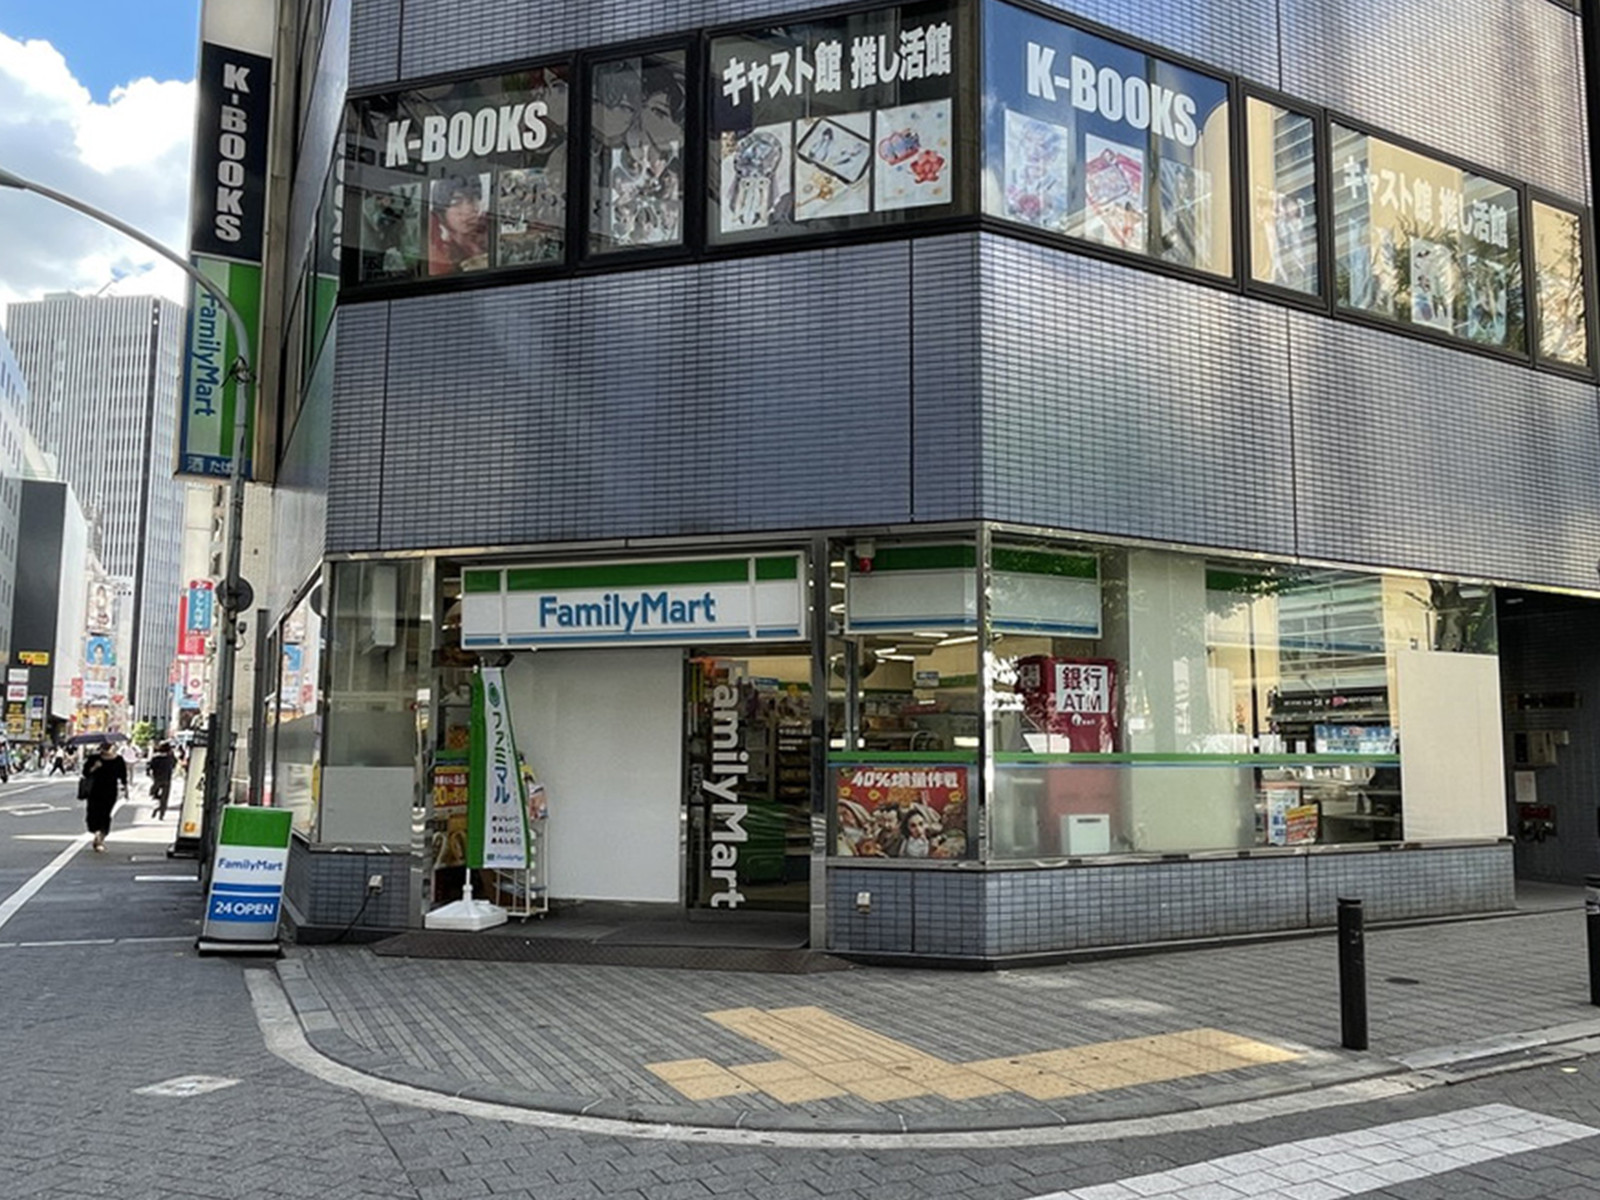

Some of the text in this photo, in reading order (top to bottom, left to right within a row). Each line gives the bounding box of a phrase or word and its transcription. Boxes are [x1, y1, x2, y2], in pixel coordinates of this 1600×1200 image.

[723, 22, 951, 107] キャスト館 推し活館
[1027, 41, 1198, 147] K-BOOKS
[215, 63, 250, 243] K-BOOKS
[385, 100, 548, 168] K-BOOKS
[1343, 155, 1433, 223] キャスト館
[539, 592, 716, 633] FamilyMart
[1062, 666, 1103, 691] 銀行
[1062, 693, 1103, 711] ATM
[492, 711, 510, 804] ファミマル
[218, 857, 283, 872] FamilyMart
[215, 901, 275, 916] 24 OPEN
